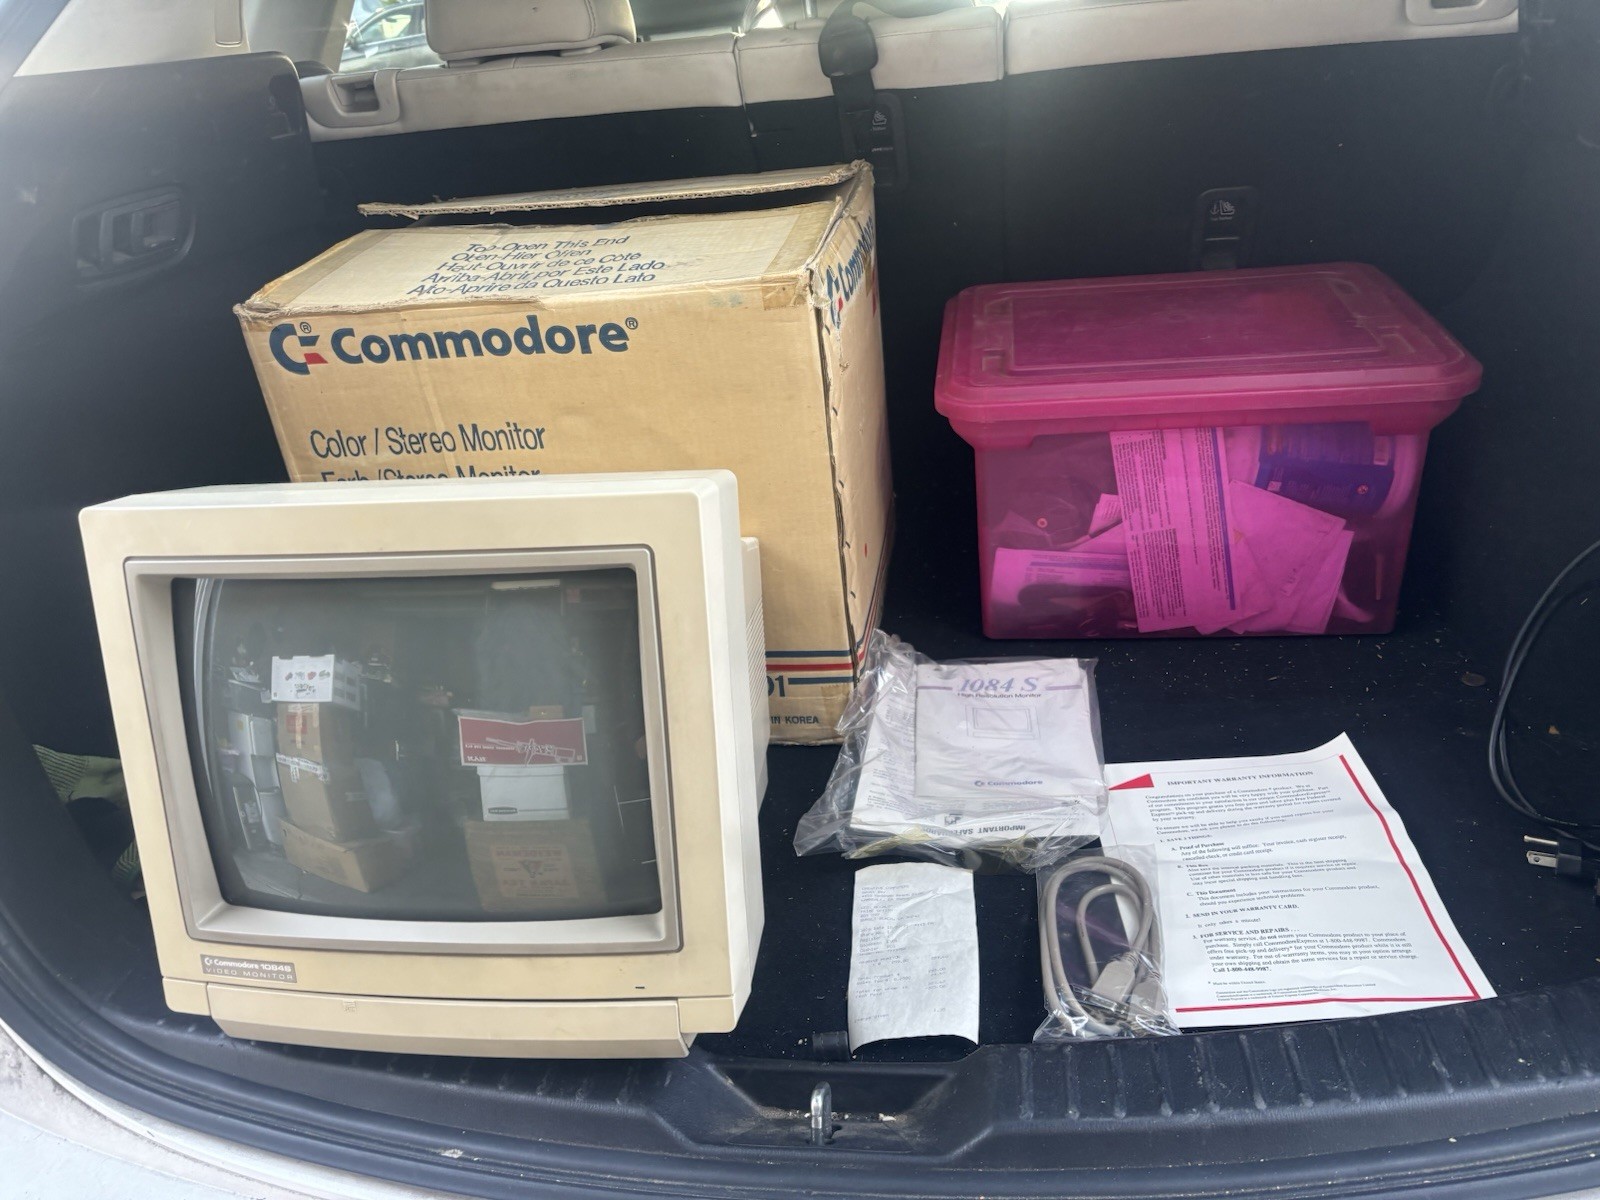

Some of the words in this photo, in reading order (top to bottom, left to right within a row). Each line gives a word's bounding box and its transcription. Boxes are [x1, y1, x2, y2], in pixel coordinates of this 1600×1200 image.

[554, 240, 589, 250] This
[592, 236, 631, 247] End
[547, 258, 570, 267] de
[574, 257, 595, 266] ce
[421, 270, 536, 283] Arriba-Abrir
[532, 270, 571, 280] por
[572, 265, 613, 276] Este
[617, 260, 666, 272] Lado
[513, 280, 538, 289] da
[542, 275, 609, 288] Questo
[612, 271, 656, 283] Lato
[310, 428, 367, 459] Color
[374, 427, 380, 456] /
[385, 425, 457, 455] Stereo
[458, 421, 546, 452] Monitor
[960, 677, 1014, 692] 1084
[1020, 676, 1041, 692] S
[785, 716, 820, 724] KOREA
[1167, 778, 1212, 786] IMPORTANT
[1213, 774, 1257, 782] WARRANTY
[1258, 770, 1313, 779] INFORMATION
[977, 825, 1026, 835] IMPORTANT
[213, 959, 260, 970] Commodore
[205, 967, 237, 976] VIDEO
[242, 971, 293, 980] MONITOR
